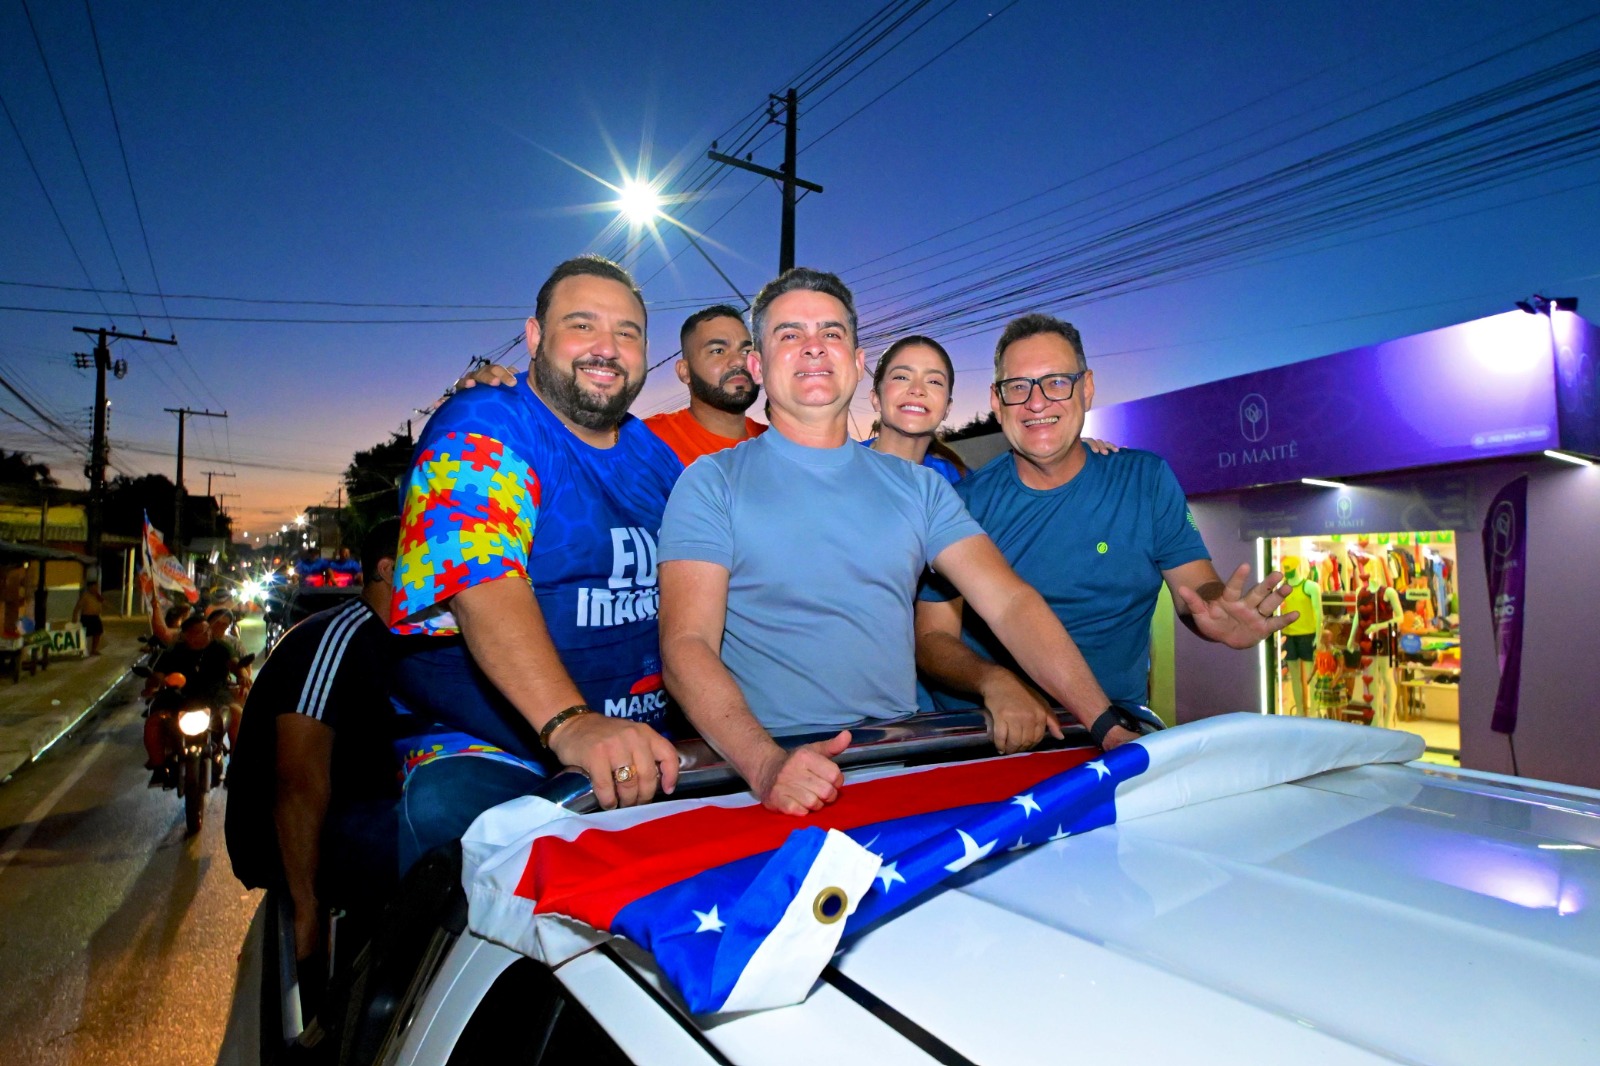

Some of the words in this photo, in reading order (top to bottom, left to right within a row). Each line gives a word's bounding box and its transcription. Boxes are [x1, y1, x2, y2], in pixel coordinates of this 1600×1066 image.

[1218, 451, 1237, 468] DI
[1242, 439, 1299, 465] MAITÊ
[608, 526, 658, 589] EU
